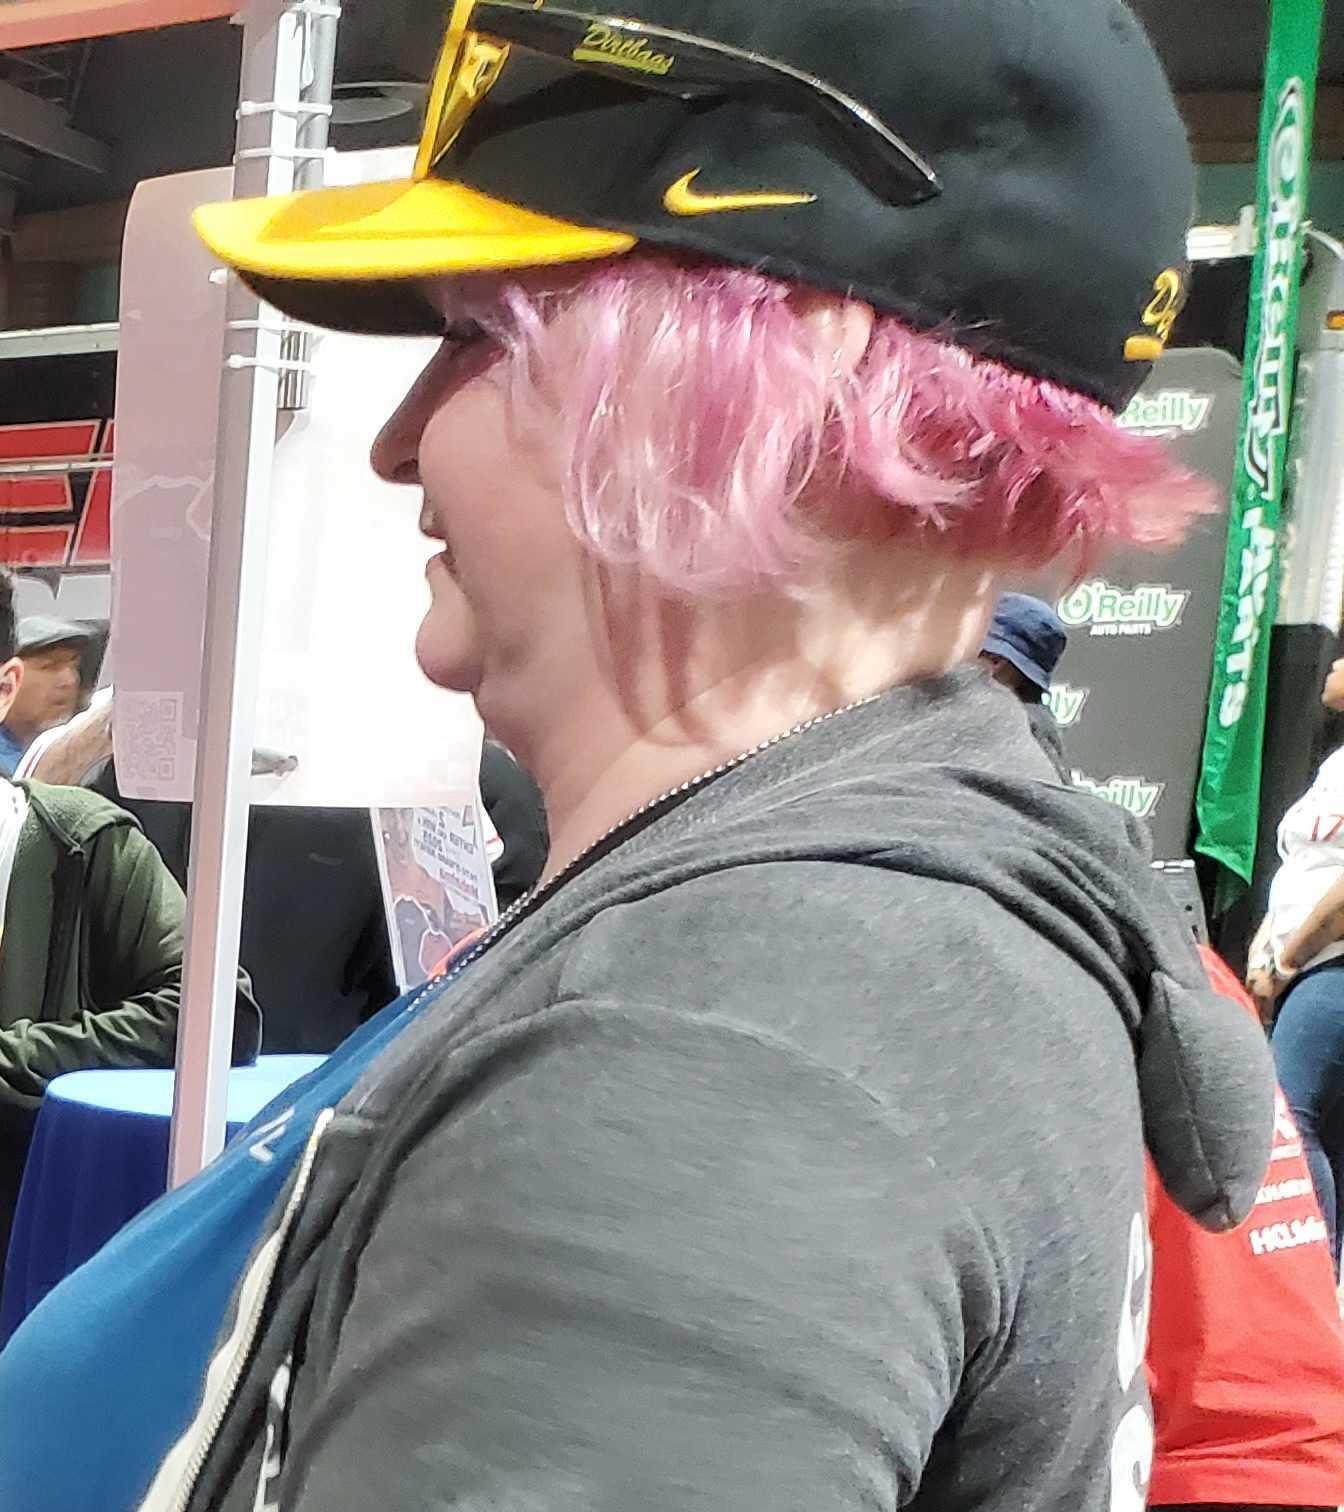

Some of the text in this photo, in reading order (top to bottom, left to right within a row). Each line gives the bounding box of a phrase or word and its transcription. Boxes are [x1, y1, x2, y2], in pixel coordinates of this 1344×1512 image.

[1116, 393, 1210, 433] Reilly
[1059, 583, 1185, 626] O'Reilly
[1090, 623, 1152, 637] AUTO PARTS
